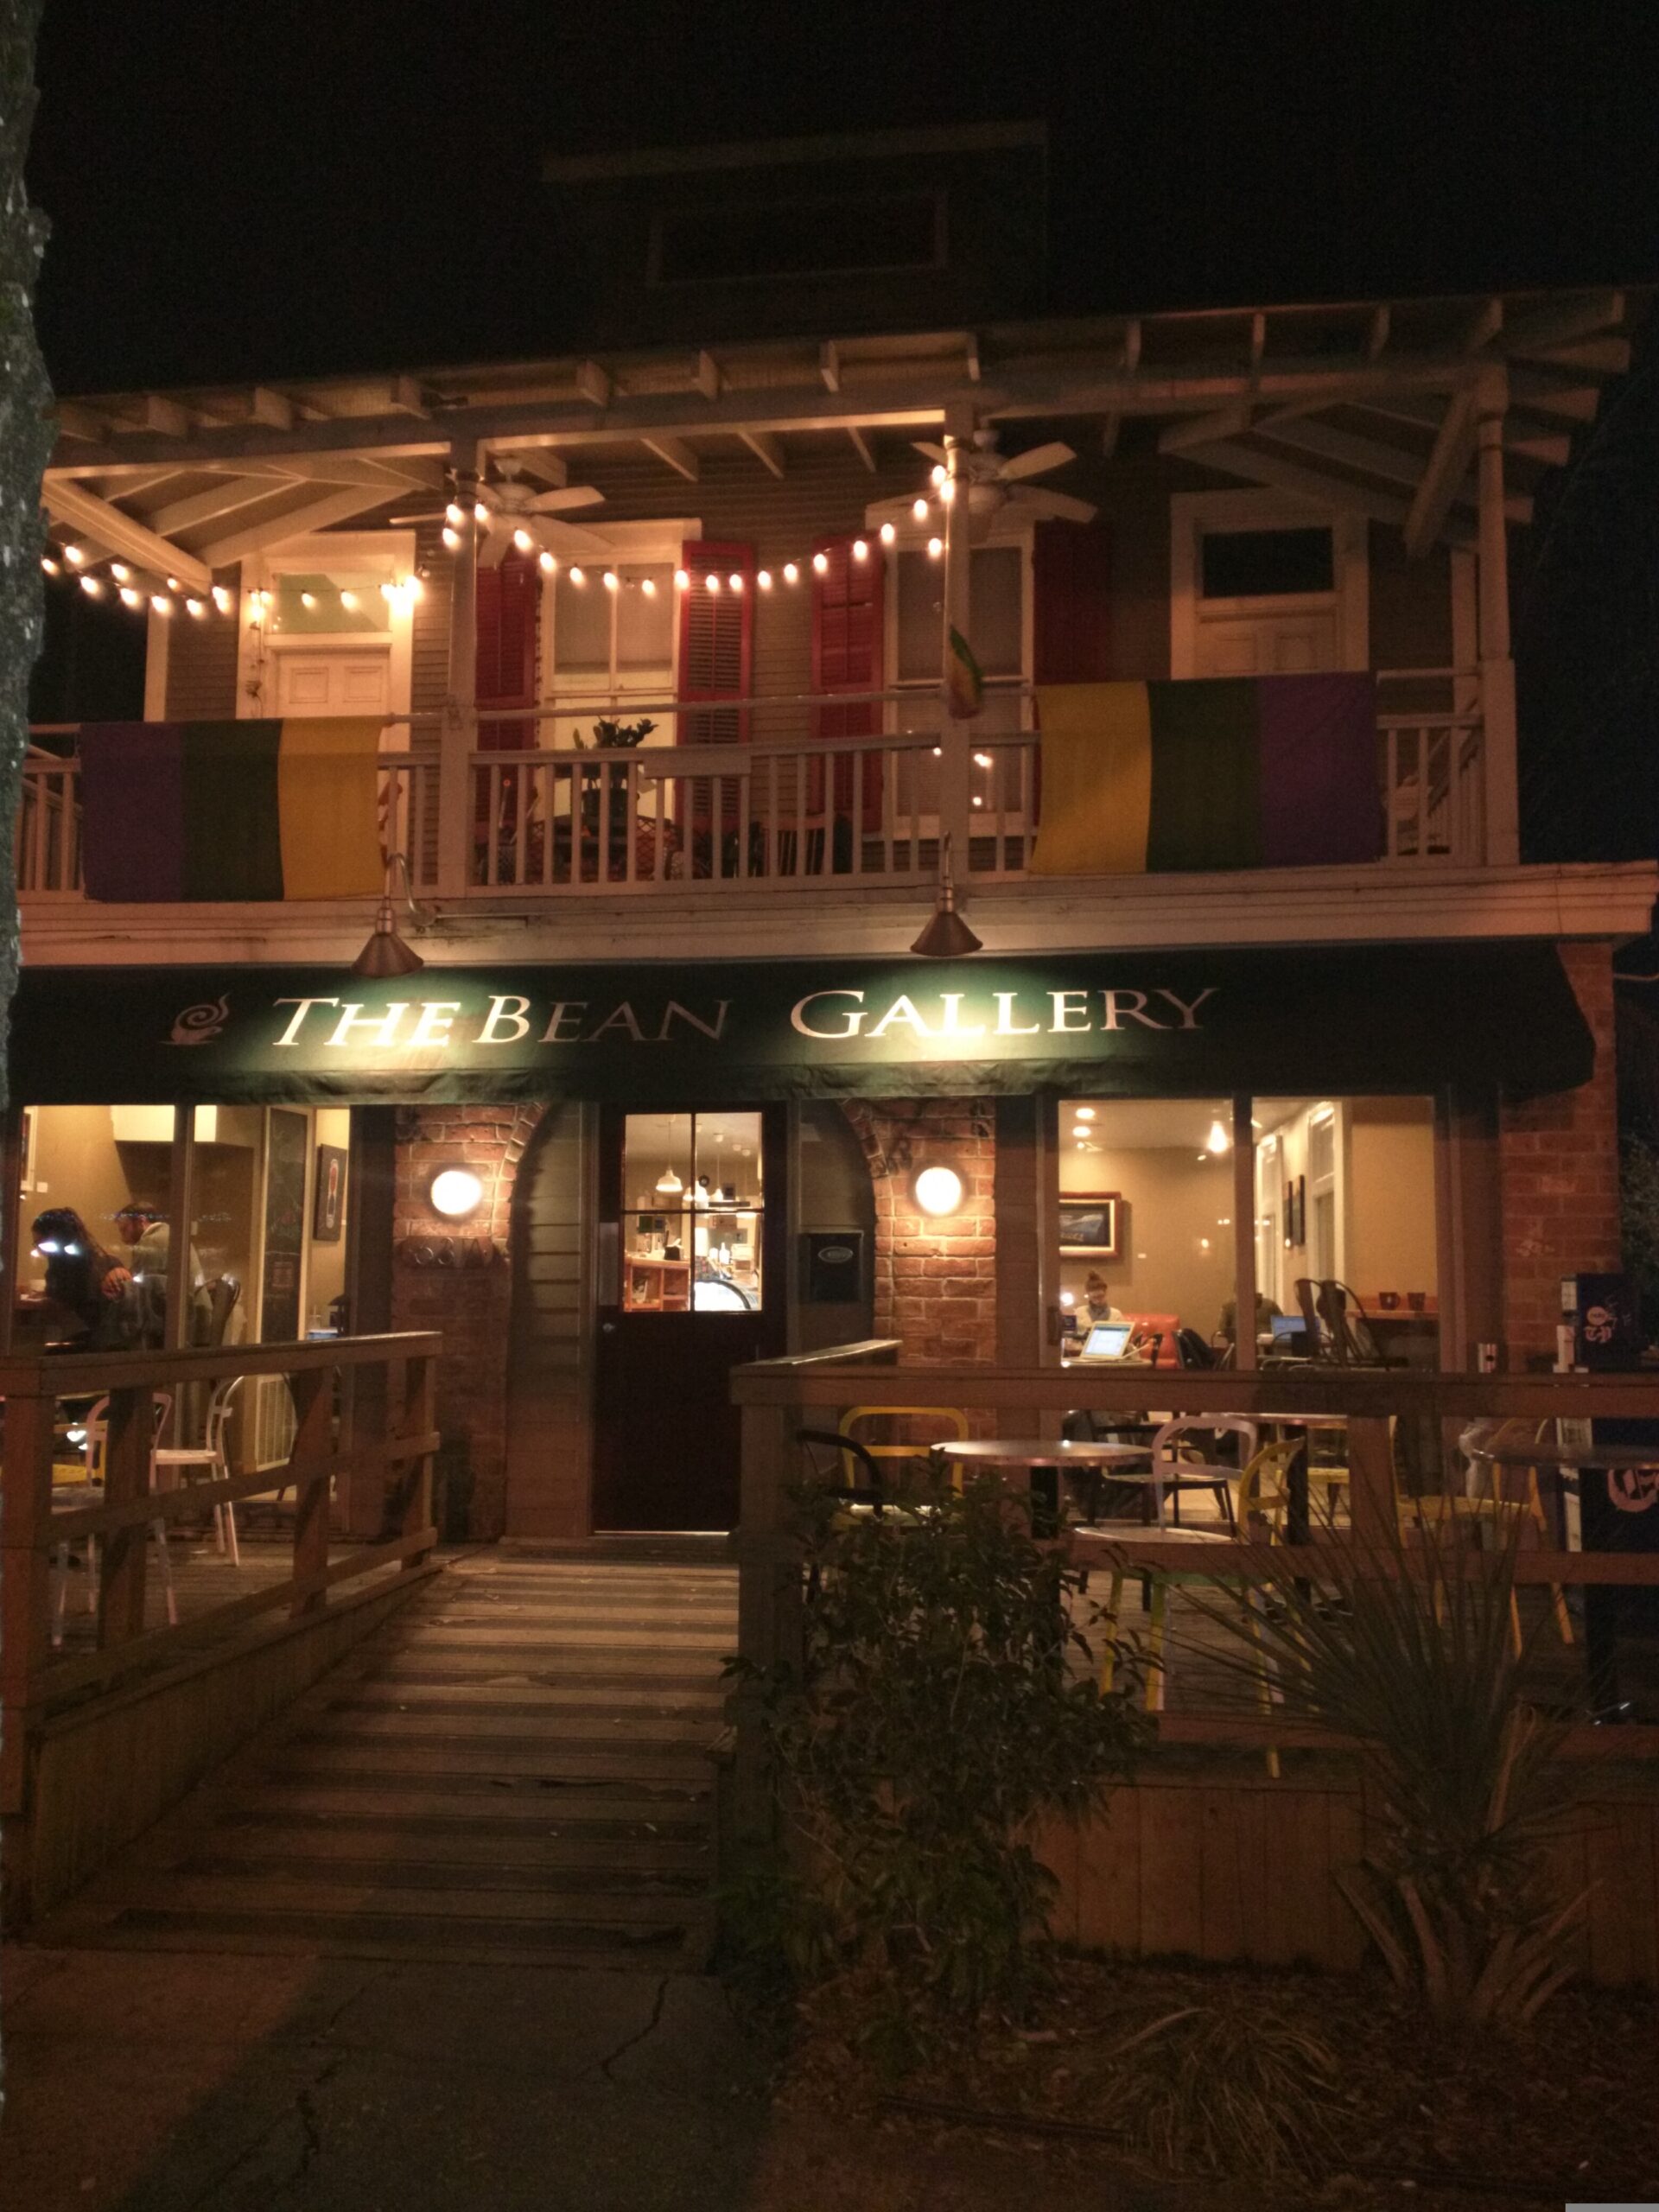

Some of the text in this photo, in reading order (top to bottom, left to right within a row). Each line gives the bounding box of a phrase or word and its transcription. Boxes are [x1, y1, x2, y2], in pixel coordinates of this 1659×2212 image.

[272, 988, 1218, 1046] THE BEAN GALLERY
